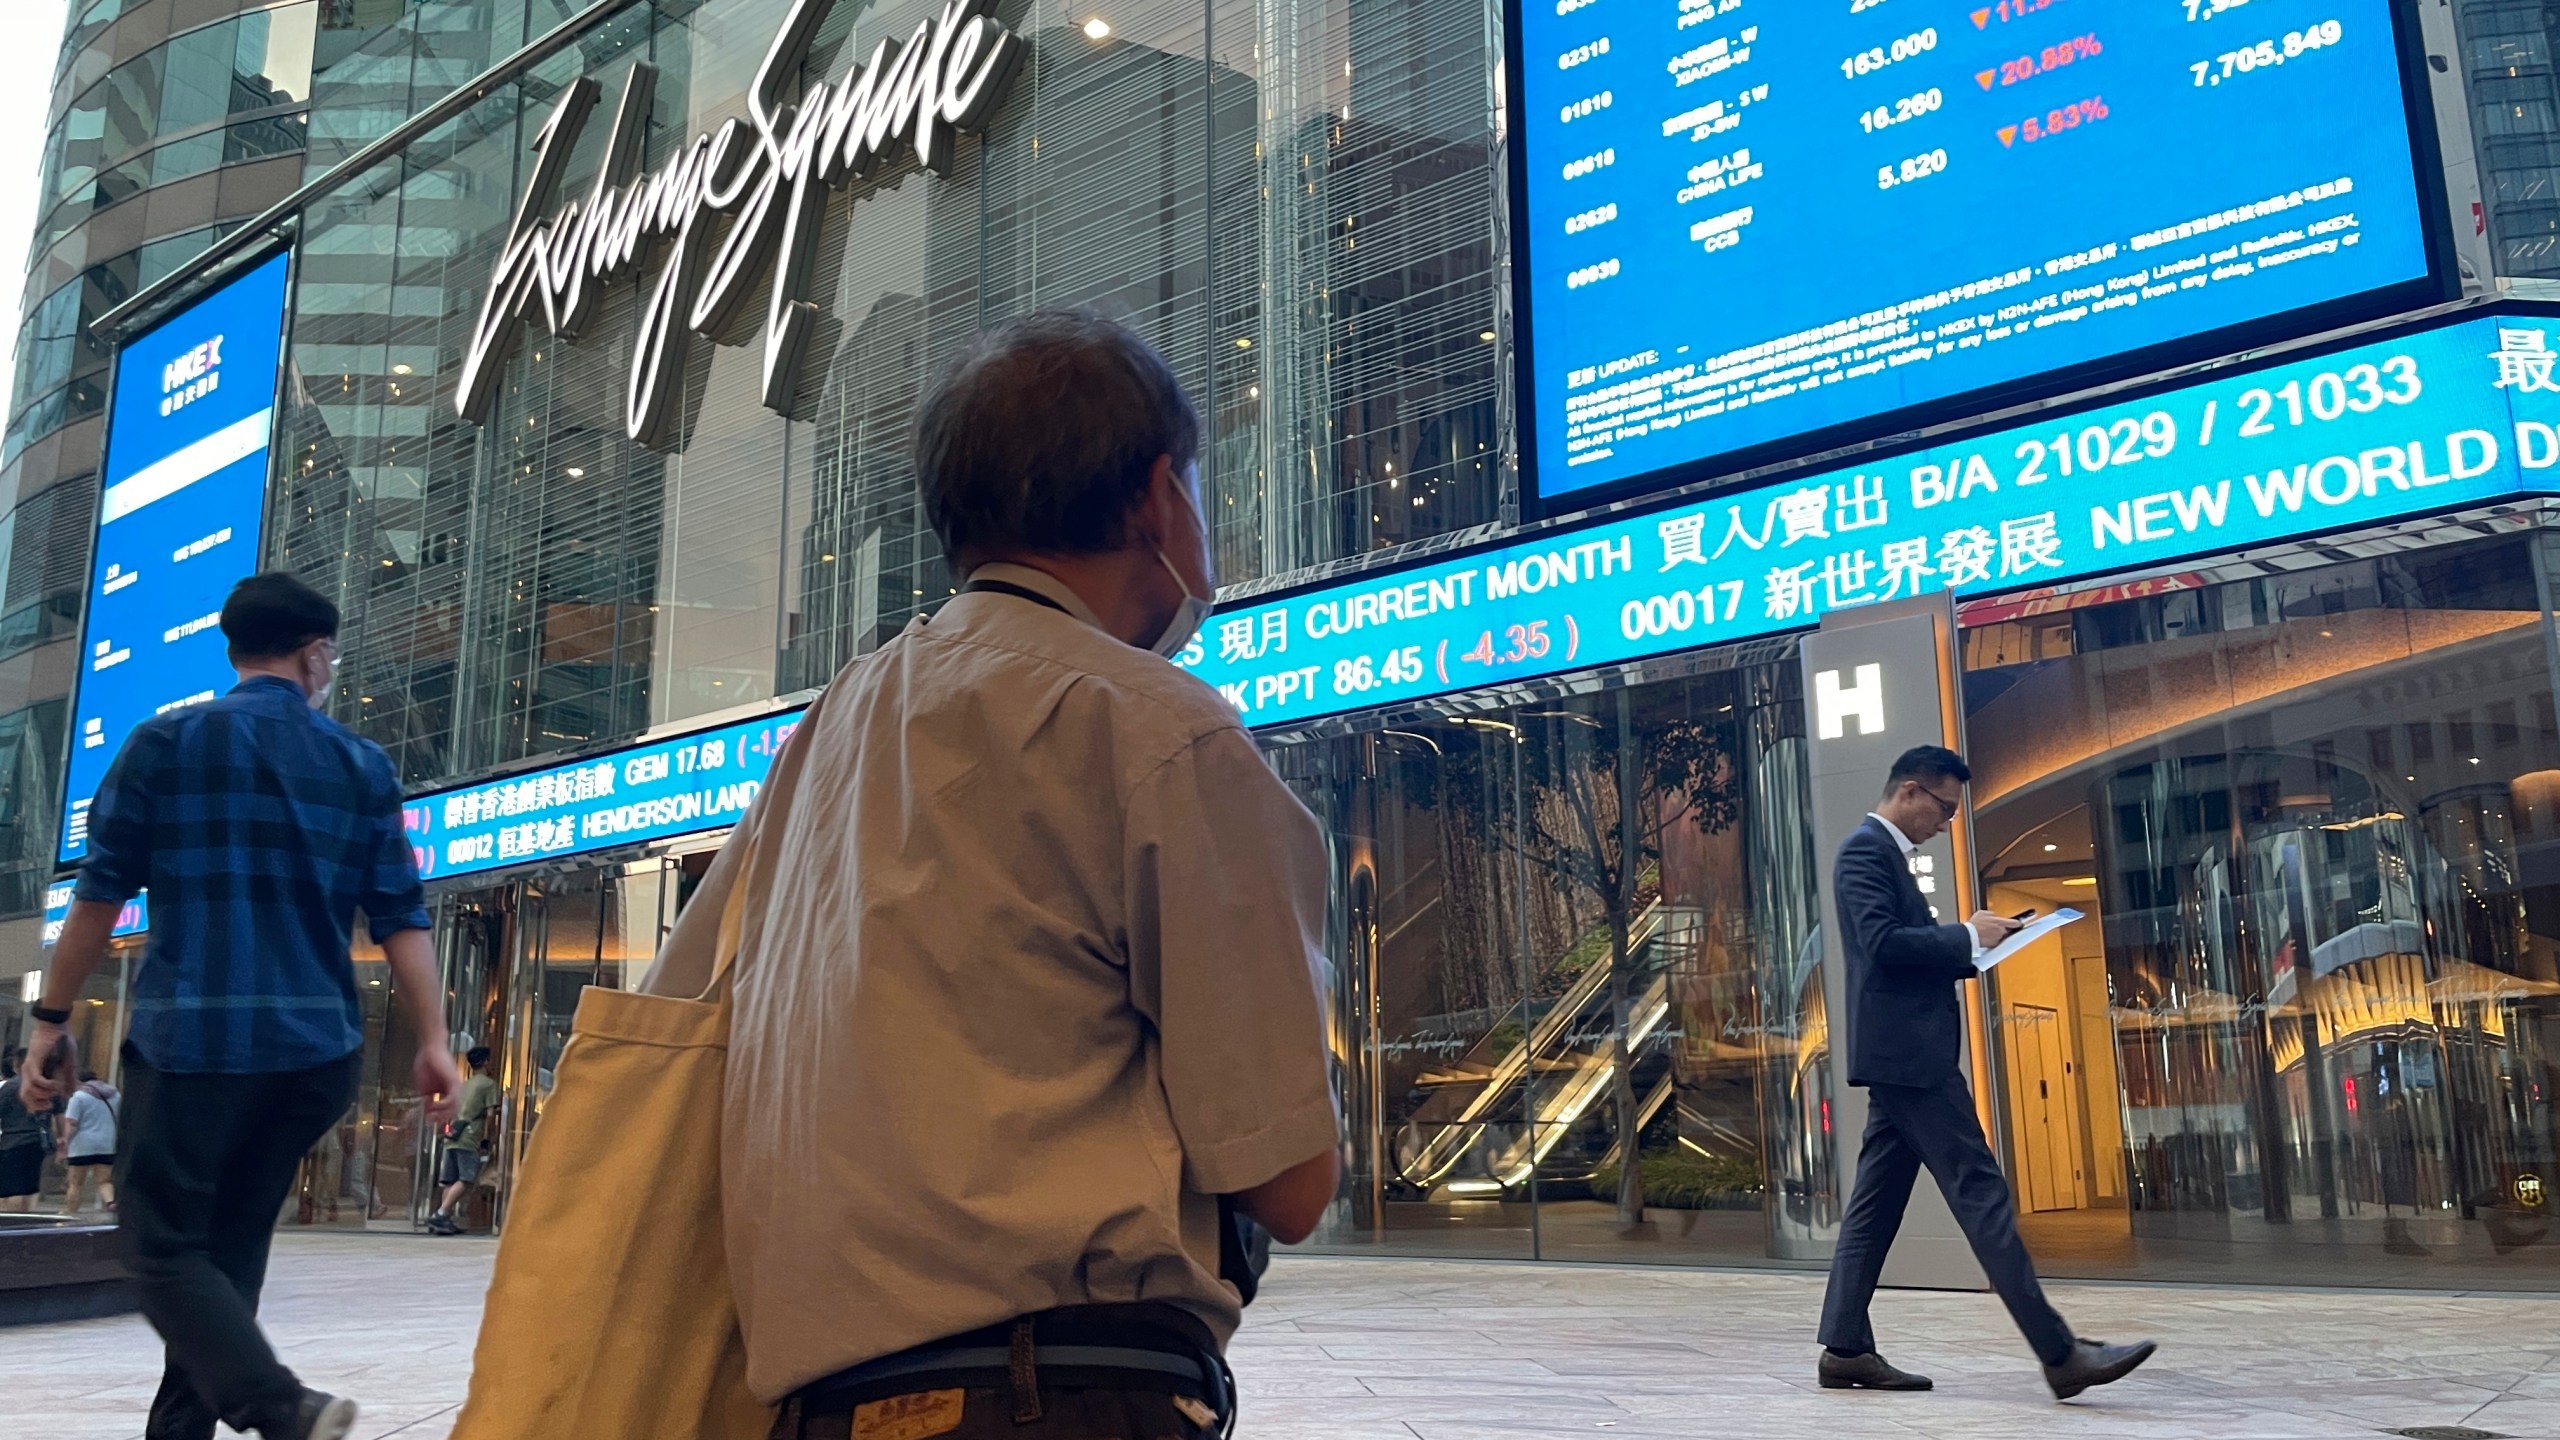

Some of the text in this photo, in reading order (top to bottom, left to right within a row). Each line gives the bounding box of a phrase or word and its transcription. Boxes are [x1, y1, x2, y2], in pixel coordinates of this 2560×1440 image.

[1840, 27, 1938, 80] 163.000
[2000, 32, 2103, 86] 20.88%
[2189, 19, 2342, 87] 7,705,849
[1859, 87, 1943, 134] 16.260
[2022, 95, 2110, 142] 5.83%
[1676, 162, 1763, 204] CHINA LIFE
[1878, 149, 1948, 190] 5.820
[456, 0, 1020, 443] Exchange Square
[1704, 230, 1740, 253] CCB
[162, 334, 224, 393] HKEX
[1598, 350, 1659, 378] UPDATE:
[1220, 607, 1288, 664] 現月
[1304, 568, 1479, 640] CURRENT
[1486, 535, 1633, 602] MONTH
[1657, 474, 1888, 573] 買入/賣出
[1910, 453, 1999, 510] B/A
[2014, 410, 2177, 488] 21029
[2237, 354, 2424, 438] 21033
[2487, 328, 2560, 393] 最
[1256, 665, 1321, 711] PPT
[1333, 645, 1423, 696] 86.45
[1620, 579, 1745, 641] 00017
[1763, 510, 2065, 622] 新世界發展
[2090, 479, 2231, 549] NEW
[2243, 429, 2498, 517] WORLD
[2516, 421, 2560, 468] D
[624, 752, 669, 786] GEM
[675, 739, 725, 774] 17.68
[448, 833, 494, 864] 00012
[581, 792, 702, 839] HENDERSON
[704, 780, 760, 816] LAND
